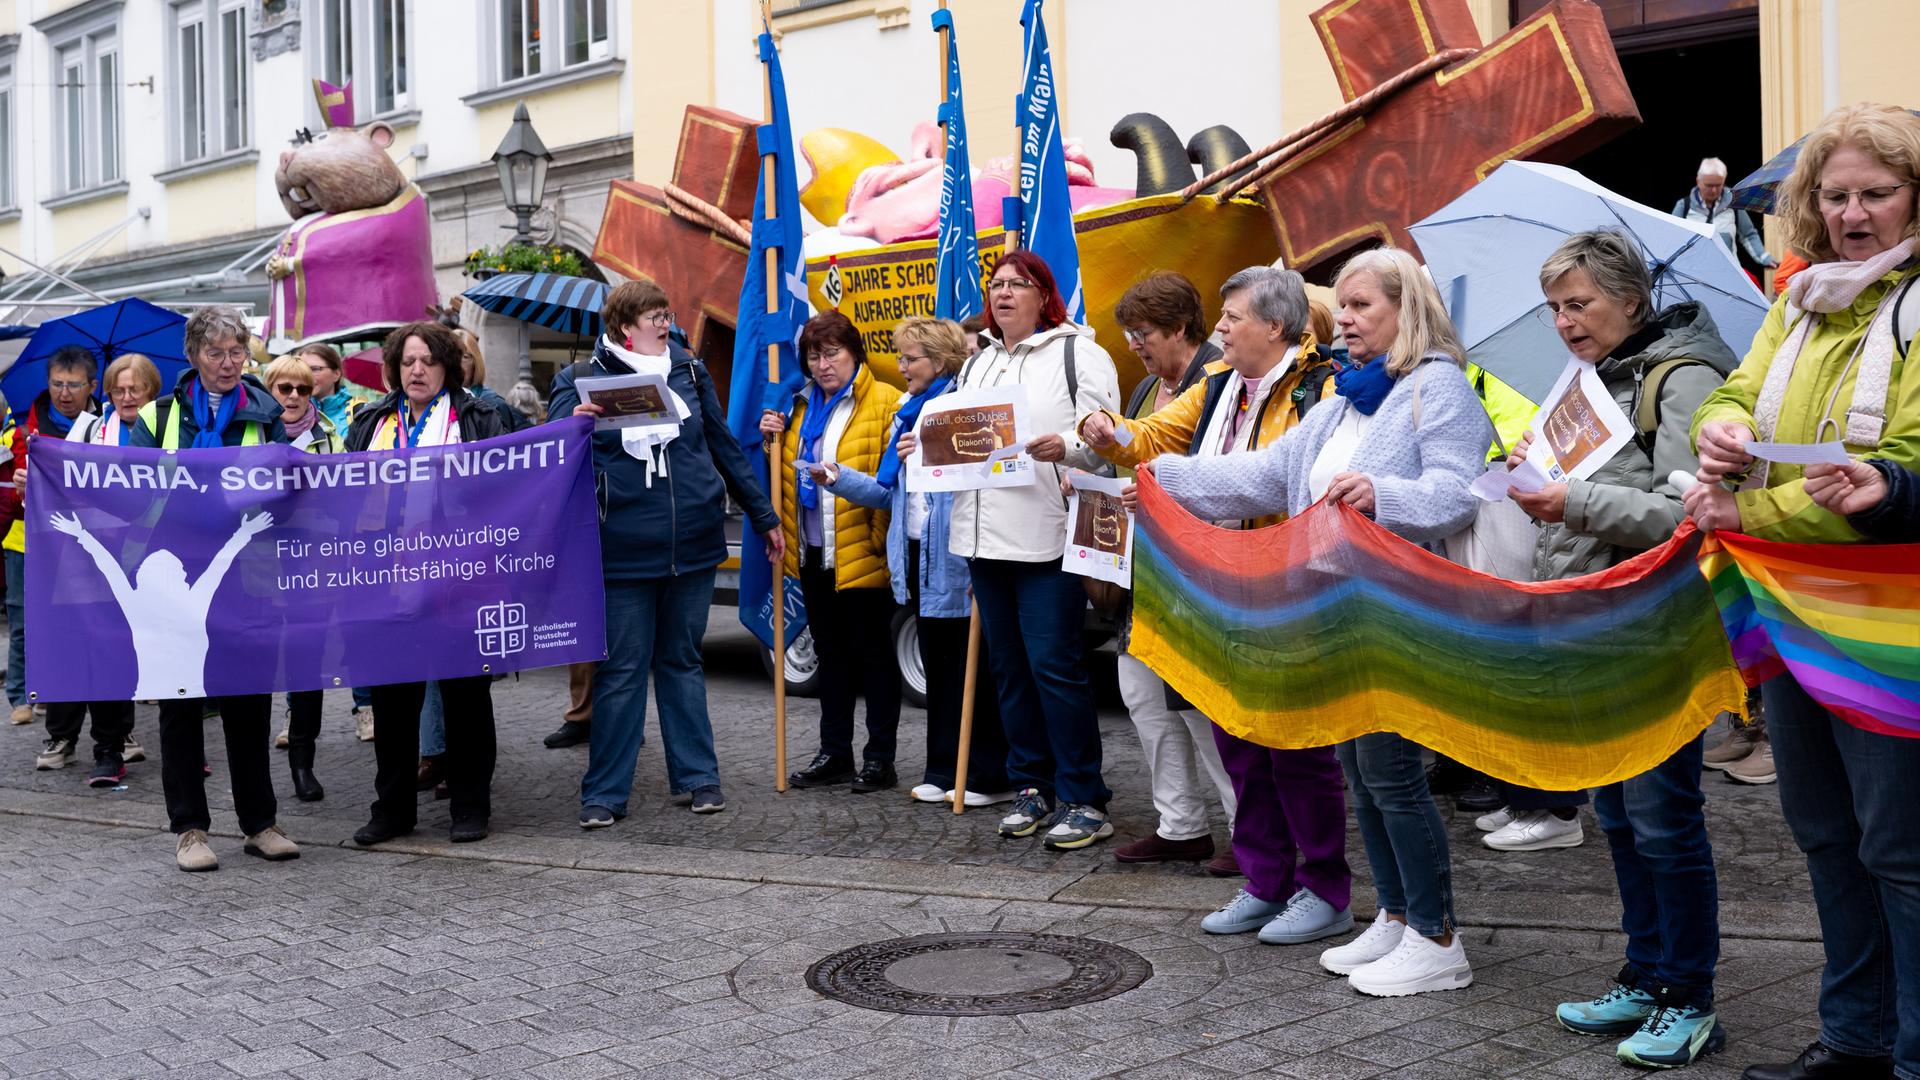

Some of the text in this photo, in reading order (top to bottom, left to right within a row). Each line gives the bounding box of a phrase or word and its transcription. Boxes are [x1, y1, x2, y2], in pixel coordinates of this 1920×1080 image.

[1028, 63, 1051, 119] Main
[1024, 122, 1041, 157] am
[845, 266, 891, 293] JAHRE
[854, 292, 937, 323] AUFARBEITU
[954, 413, 976, 424] dass
[63, 439, 565, 494] MARIA, SCHWEIGE NICHT!
[276, 524, 520, 559] Für eine glaubwürdige
[277, 551, 555, 591] und zukunftsfähige Kirche
[533, 621, 577, 633] Katholischer
[533, 631, 570, 642] Deutscher
[534, 638, 577, 650] Frauenbund
